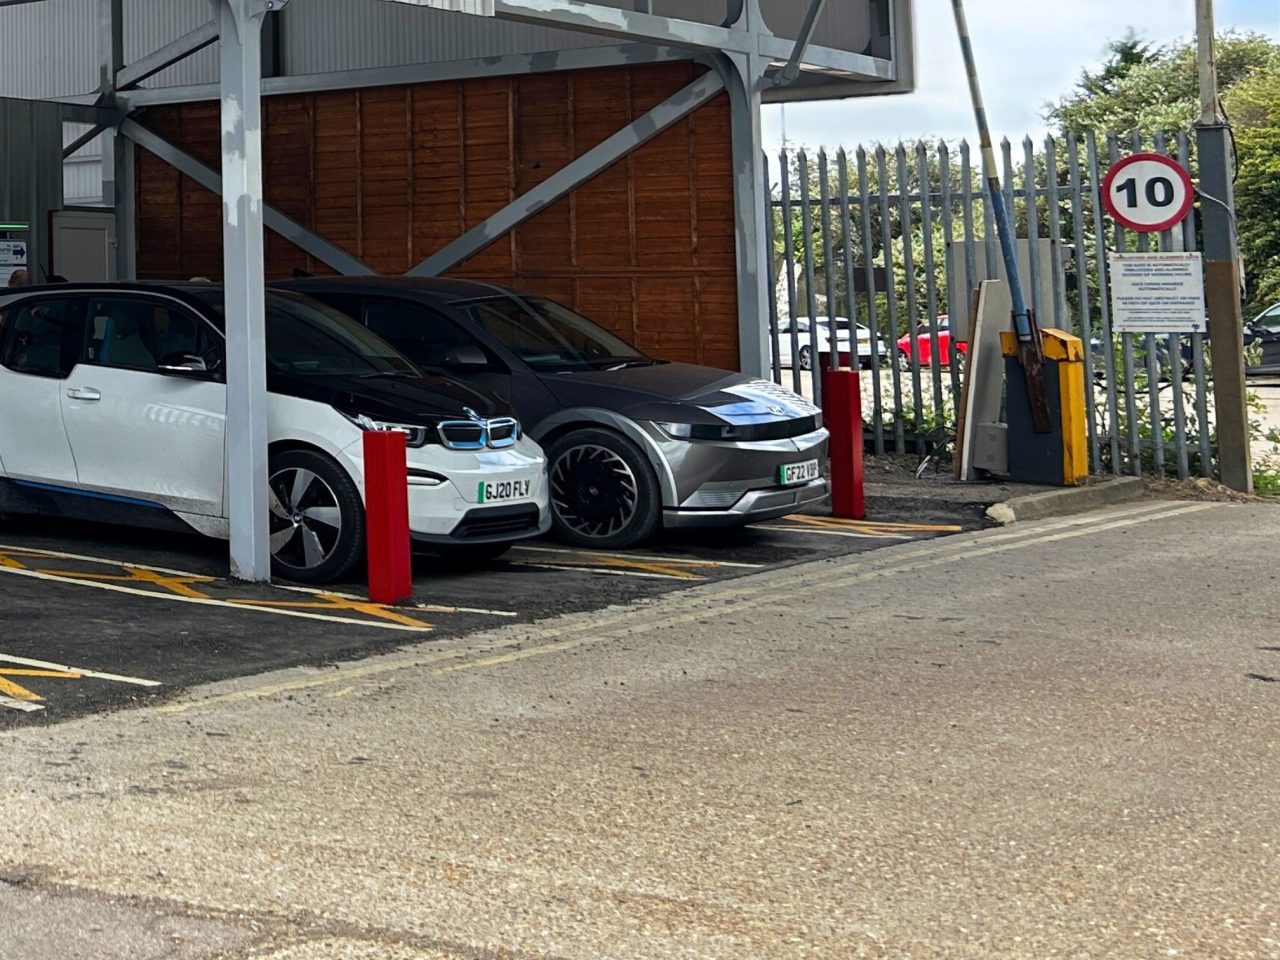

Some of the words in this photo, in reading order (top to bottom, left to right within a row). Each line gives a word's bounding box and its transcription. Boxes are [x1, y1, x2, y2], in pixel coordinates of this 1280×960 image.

[1116, 176, 1174, 208] 10
[786, 464, 805, 482] GF22
[486, 482, 512, 500] GJ20
[513, 479, 530, 497] FLY
